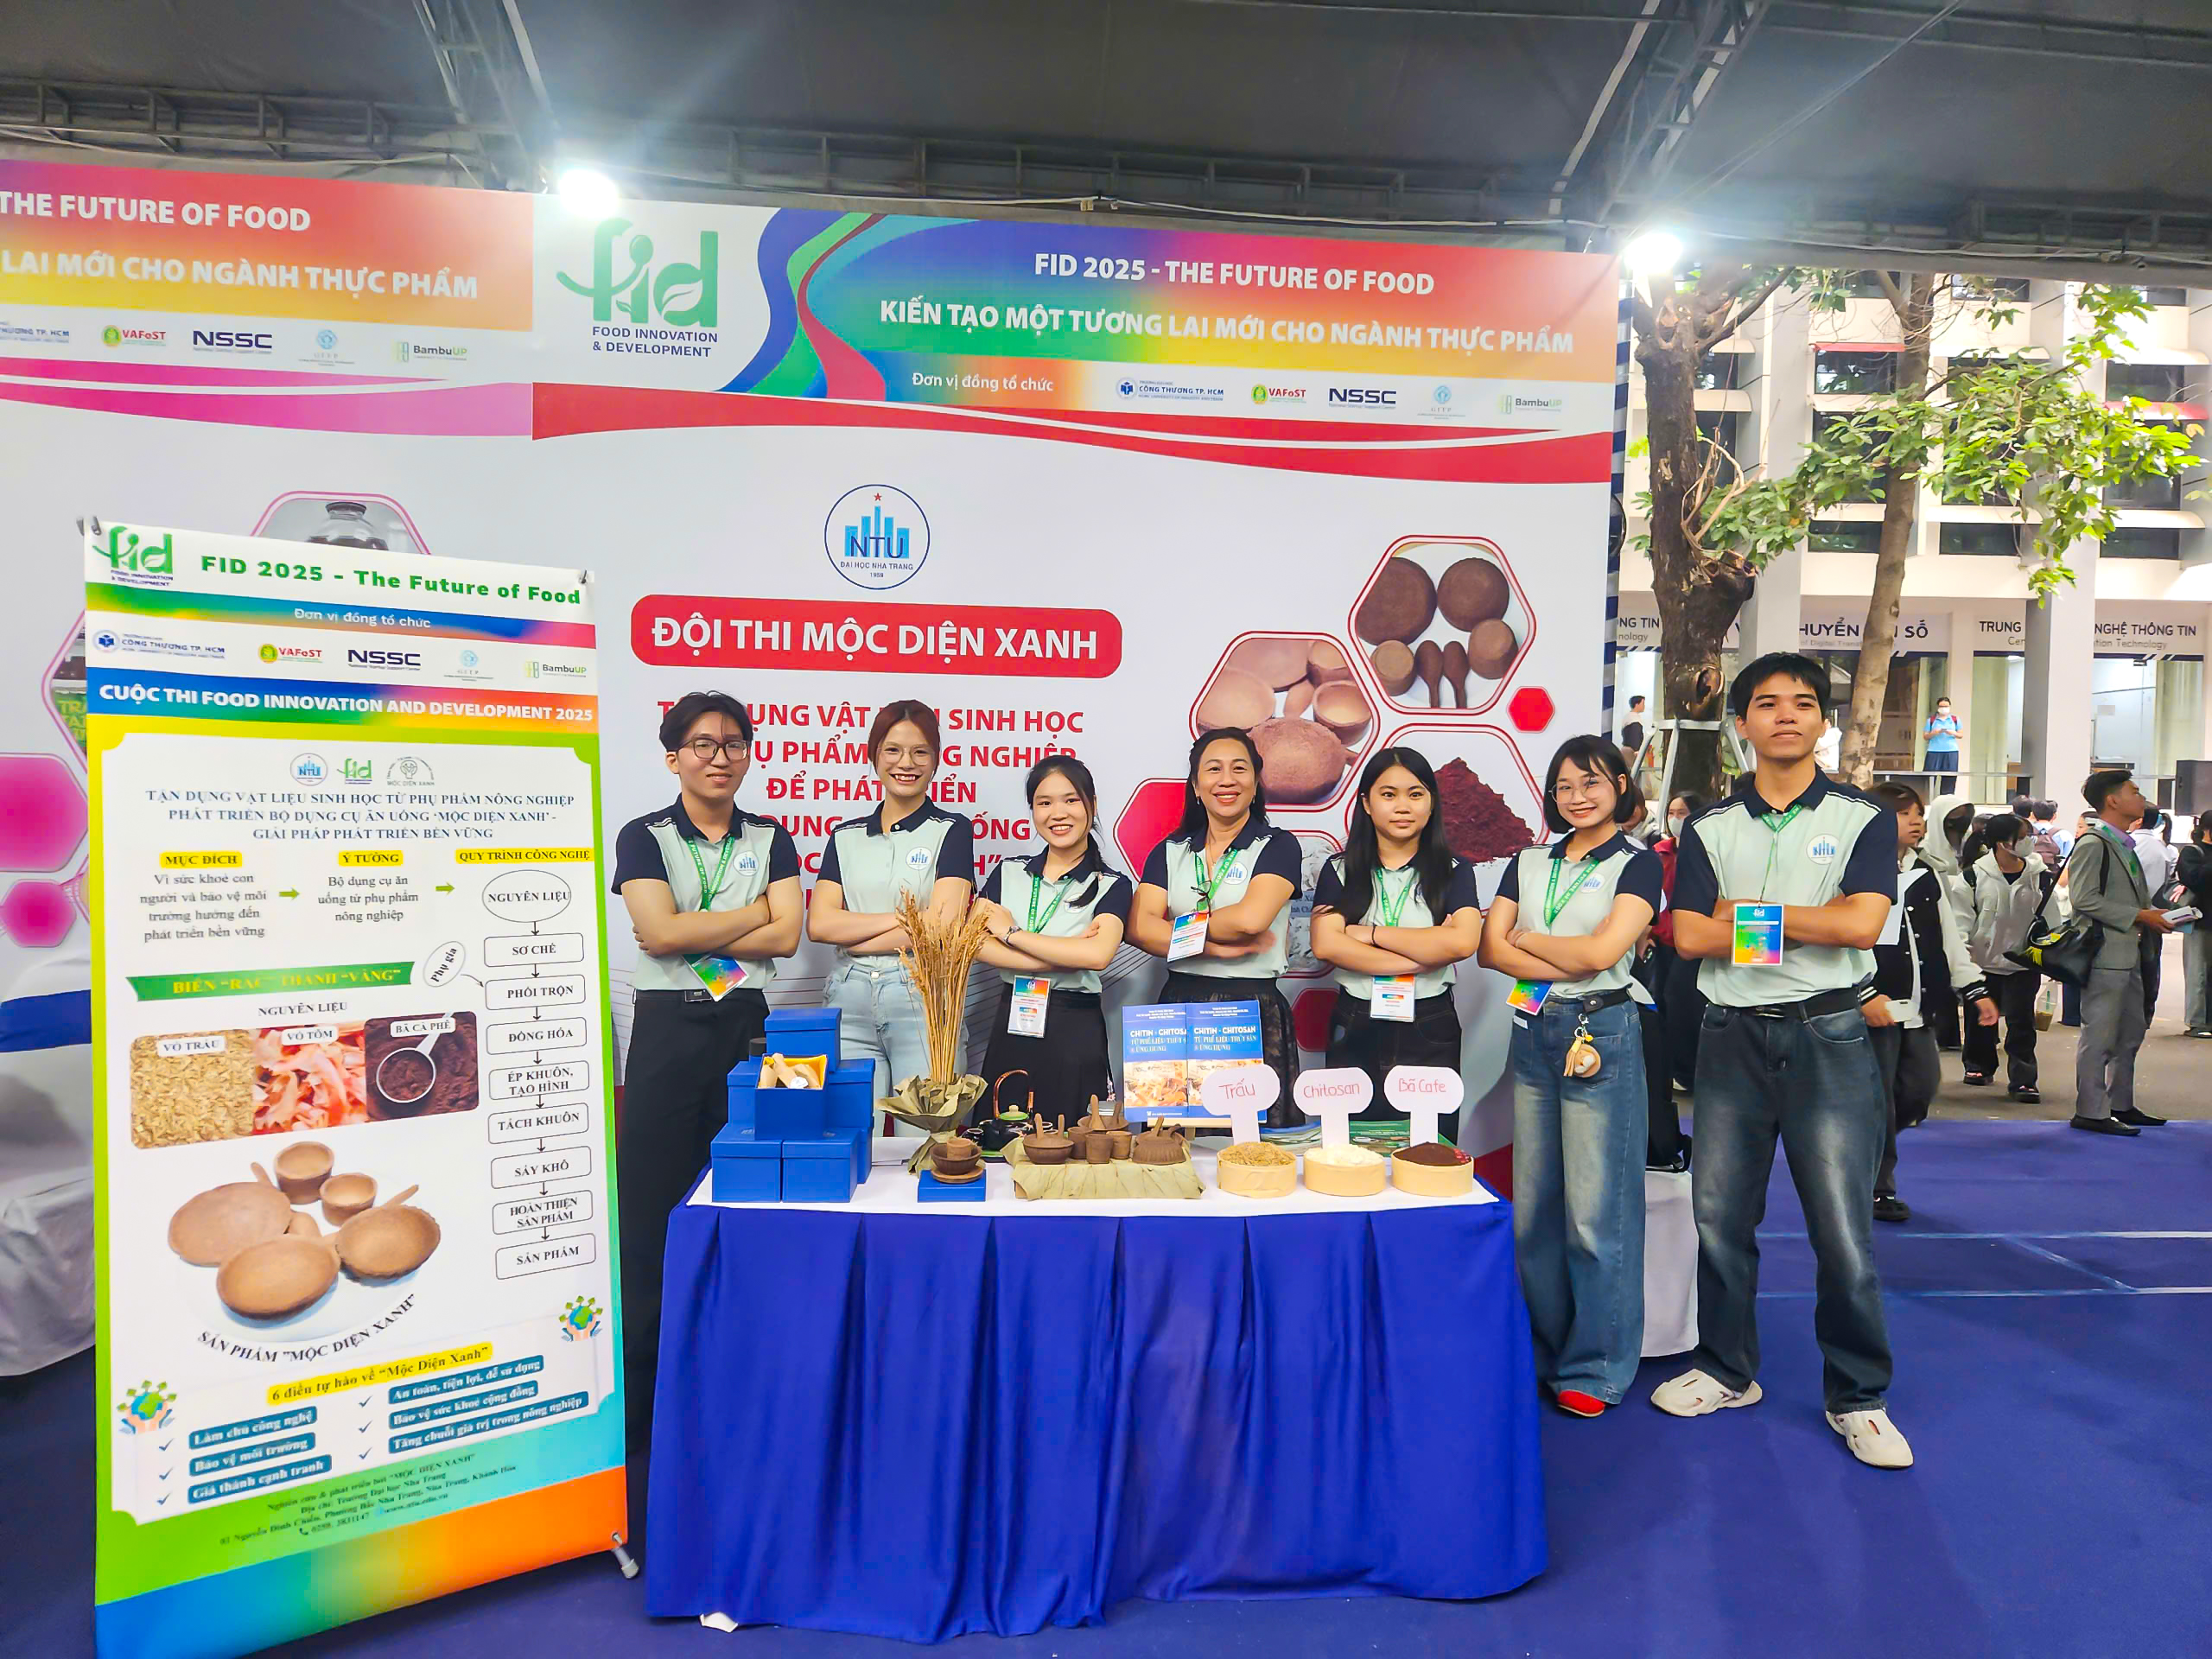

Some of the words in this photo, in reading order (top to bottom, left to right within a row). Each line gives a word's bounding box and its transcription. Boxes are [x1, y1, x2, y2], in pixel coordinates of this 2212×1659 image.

[0, 192, 53, 216] THE
[60, 195, 174, 223] FUTURE
[181, 202, 220, 226] OF
[227, 205, 310, 231] FOOD
[2, 250, 48, 274] LAI
[58, 251, 115, 276] MỚI
[123, 257, 185, 282] CHO
[193, 257, 299, 288] NGÀNH
[304, 266, 385, 299] THỰC
[393, 267, 478, 298] PHẨM
[1035, 253, 1077, 276] FID
[1084, 257, 1145, 281] 2025
[1165, 261, 1213, 284] THE
[1221, 263, 1318, 289] FUTURE
[1324, 269, 1357, 292] OF
[1363, 270, 1434, 295] FOOD
[880, 295, 941, 325] KIẾN
[947, 303, 999, 334] TẠO
[1006, 303, 1064, 336] MỘT
[1069, 308, 1162, 336] TƯƠNG
[1169, 315, 1209, 338] LAI
[1216, 315, 1265, 341] MỚI
[1273, 321, 1325, 343] CHO
[1331, 321, 1421, 349] NGÀNH
[1427, 327, 1494, 356] THỰC
[1501, 325, 1573, 353] PHẨM
[123, 329, 166, 340] VAFoST
[193, 330, 272, 349] NSSC
[593, 327, 631, 338] FOOD
[635, 328, 718, 343] INNOVATION
[413, 345, 467, 356] BambuUP
[593, 340, 601, 352] &
[606, 342, 711, 358] DEVELOPMENT
[912, 372, 942, 387] Đơn
[946, 375, 958, 391] vị
[962, 373, 998, 392] đồng
[1003, 375, 1017, 391] tổ
[1021, 377, 1052, 391] chức
[1162, 386, 1193, 395] THƯƠNG
[1268, 388, 1306, 398] VAFoST
[1329, 388, 1396, 404] NSSC
[1516, 398, 1562, 407] BambuUP
[92, 526, 173, 574] fid
[851, 536, 903, 558] NTU
[200, 556, 247, 574] FID
[257, 562, 322, 581] 2025
[353, 570, 400, 588] The
[410, 575, 489, 596] Future
[498, 584, 520, 599] of
[528, 587, 581, 604] Food
[295, 608, 323, 621] Đơn
[327, 611, 339, 624] vị
[343, 612, 377, 626] đồng
[381, 614, 395, 626] tổ
[399, 616, 431, 628] chức
[1641, 618, 1659, 628] TIN
[1799, 617, 1859, 638] HUYỂN
[1904, 620, 1929, 639] SỐ
[1980, 621, 2022, 632] TRUNG
[2094, 621, 2127, 638] NGHỆ
[2131, 621, 2174, 636] THÔNG
[2177, 625, 2196, 636] TIN
[652, 613, 721, 657] ĐỘI
[729, 620, 791, 651] THI
[803, 617, 887, 662] MỘC
[899, 620, 984, 664] DIỆN
[995, 629, 1097, 659] XANH
[2116, 638, 2168, 651] Technology
[279, 647, 322, 658] VAFoST
[348, 650, 421, 666] NSSC
[543, 664, 587, 674] BambuUP
[99, 683, 160, 705] CUỘC
[163, 688, 198, 704] THI
[201, 691, 259, 708] FOOD
[264, 694, 383, 713] INNOVATION
[387, 701, 426, 715] AND
[429, 702, 553, 721] DEVELOPMENT
[556, 709, 593, 721] 2025
[747, 703, 810, 733] ỤNG
[817, 701, 871, 734] VẬT
[949, 709, 1016, 732] SINH
[1025, 710, 1084, 740] HỌC
[782, 734, 868, 765] PHẨM
[766, 769, 805, 800] ĐỂ
[814, 775, 882, 802] PHÁT
[972, 811, 1031, 841] ỐNG
[460, 852, 484, 862] QUY
[487, 849, 522, 861] TRÌNH
[525, 849, 556, 860] CÔNG
[560, 849, 590, 861] NGHỆ
[328, 876, 345, 888] Bộ
[348, 876, 376, 888] dụng
[378, 878, 392, 887] cụ
[395, 875, 408, 885] ăn
[365, 893, 385, 906] phụ
[488, 891, 539, 903] NGUYÊN
[543, 891, 570, 903] LIỆU
[335, 911, 363, 923] nông
[366, 910, 404, 923] nghiệp
[512, 945, 528, 956] SƠ
[540, 985, 574, 997] TRỘN
[547, 1027, 574, 1040] HÓA
[1222, 1026, 1256, 1034] CHITOSAN
[508, 1070, 523, 1083] ÉP
[509, 1084, 536, 1098] TẠO
[538, 1079, 569, 1092] HÌNH
[1219, 1078, 1255, 1100] Trấu
[1303, 1083, 1360, 1099] Chitosan
[1398, 1078, 1415, 1093] Bã
[1418, 1077, 1446, 1093] Cafe
[498, 1118, 532, 1131] TÁCH
[536, 1112, 580, 1127] KHUÔN
[543, 1160, 569, 1173] KHÔ
[418, 1356, 445, 1370] Diện
